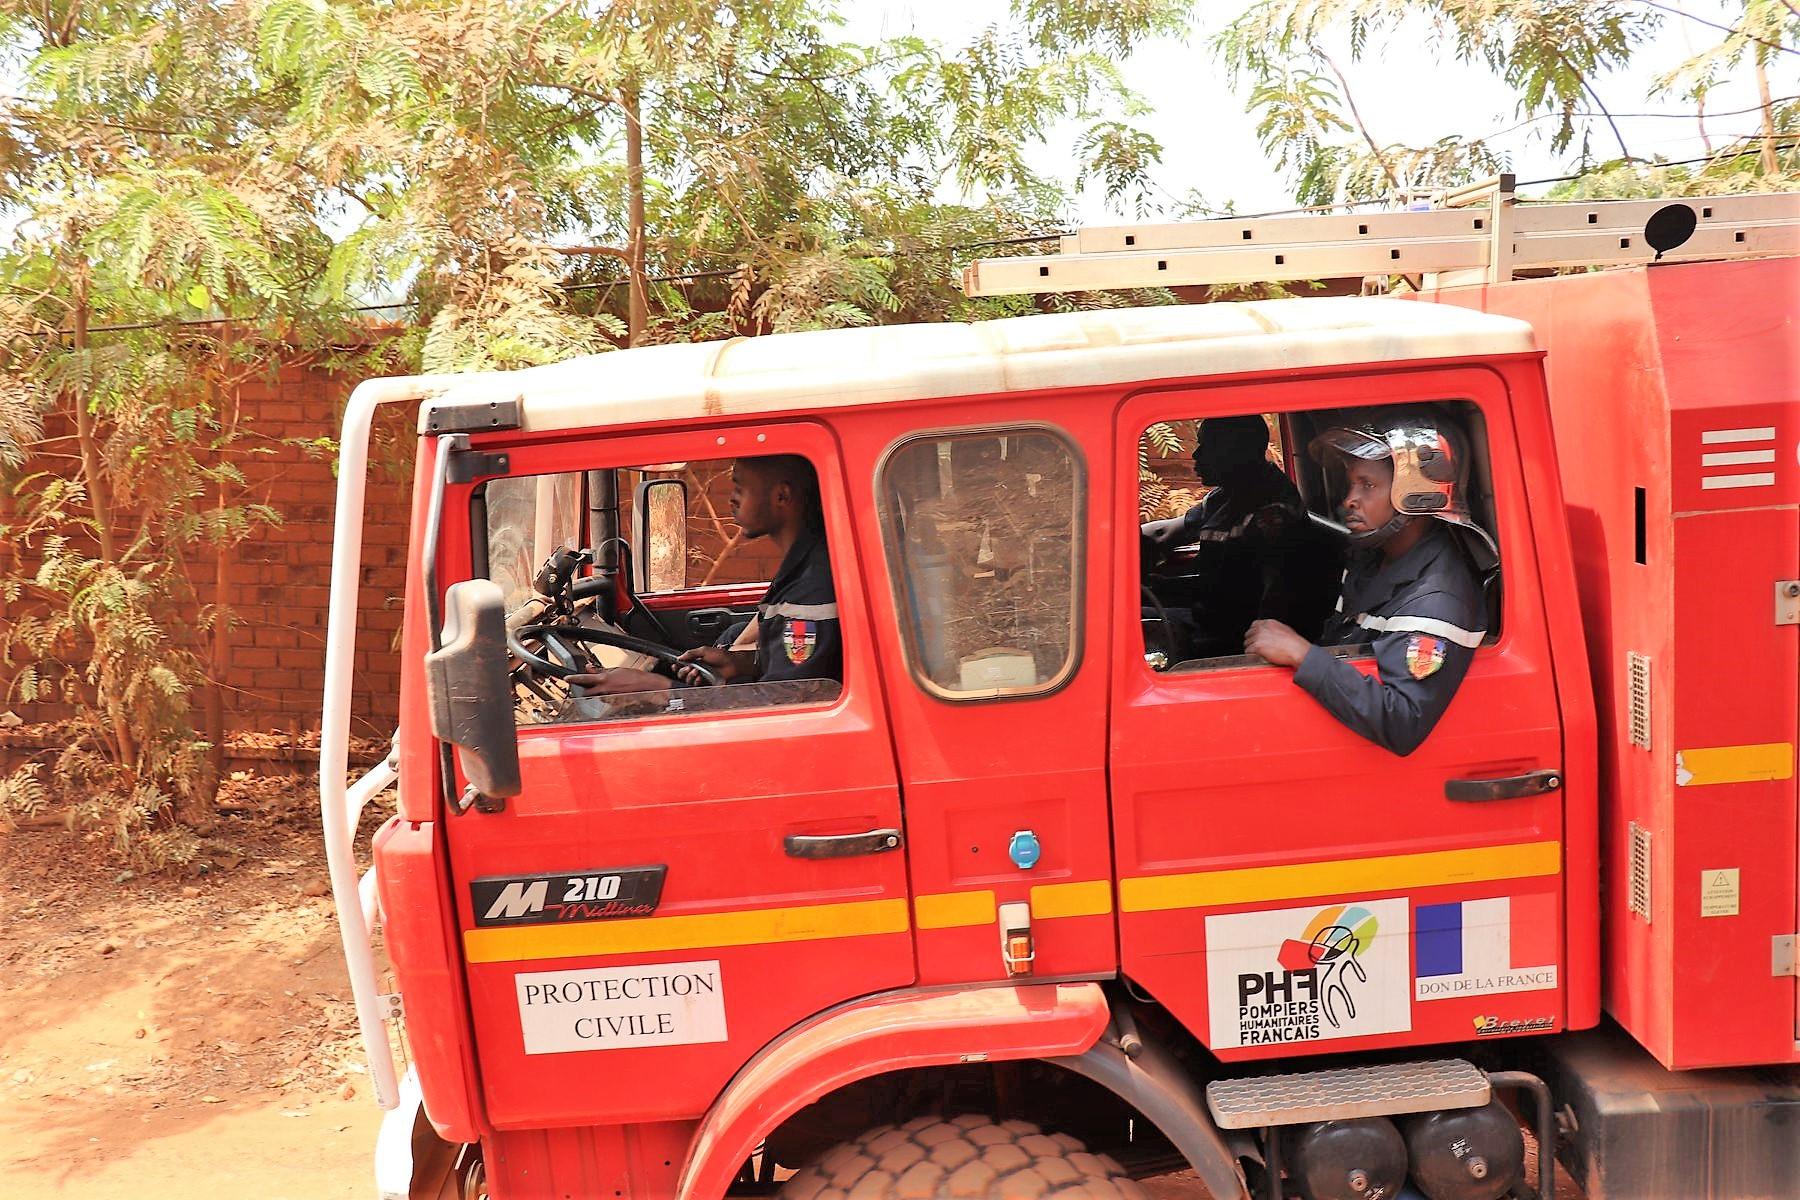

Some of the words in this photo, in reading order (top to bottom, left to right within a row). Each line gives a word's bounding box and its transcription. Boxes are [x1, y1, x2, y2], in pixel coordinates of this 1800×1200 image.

[484, 880, 549, 919] M
[563, 875, 622, 902] 210
[545, 902, 655, 919] Midliner
[524, 972, 716, 1006] PROTECTION
[1238, 967, 1319, 1007] PHF
[1420, 981, 1450, 995] DON
[1454, 979, 1472, 992] DE
[1476, 977, 1494, 989] LA
[1498, 971, 1554, 988] FRANCE
[1239, 1001, 1319, 1020] POMPIERS
[1240, 1014, 1319, 1031] HUMANITAIRES
[574, 1012, 675, 1039] CIVILE
[1240, 1024, 1320, 1045] FRANCAIS
